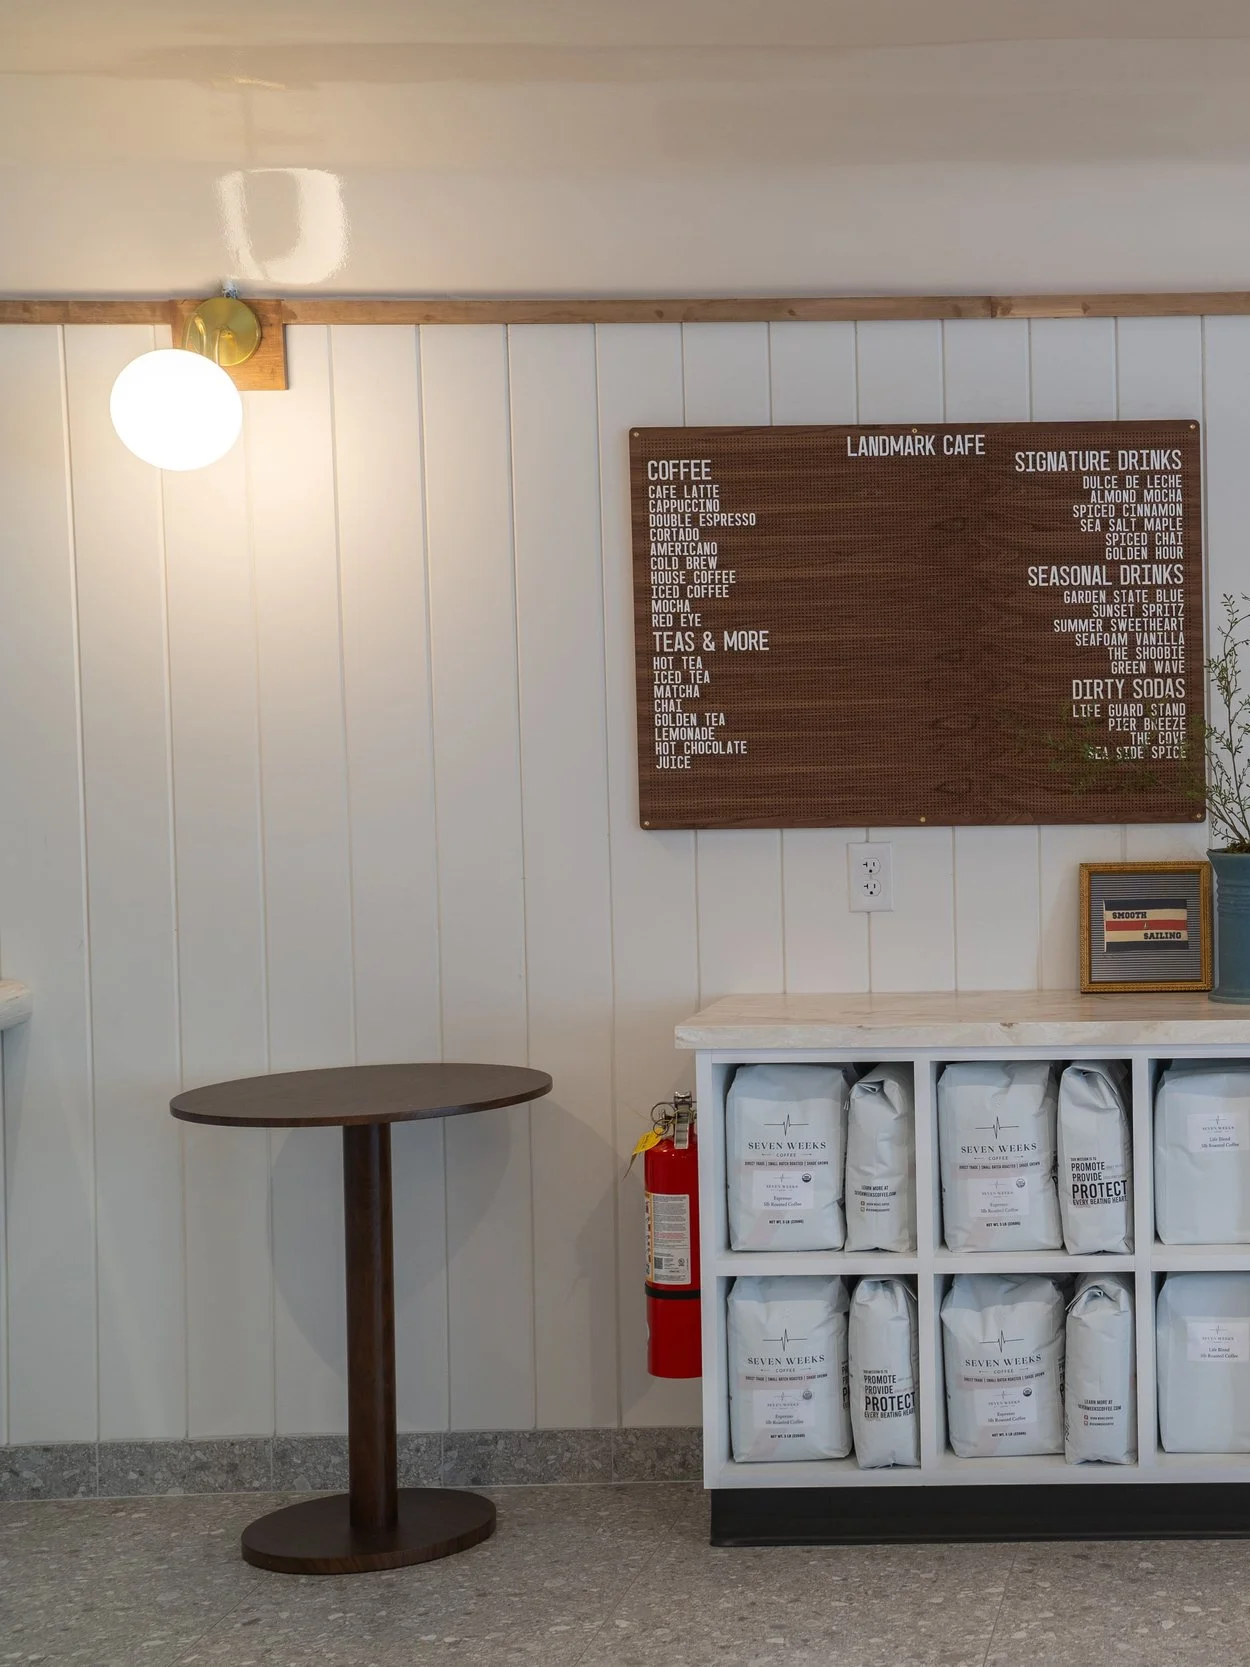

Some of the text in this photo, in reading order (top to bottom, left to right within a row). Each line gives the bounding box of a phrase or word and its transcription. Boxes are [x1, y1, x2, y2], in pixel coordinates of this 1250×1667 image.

[847, 435, 985, 456] LANDMARK CAFE
[1016, 450, 1181, 471] SIGNATURE DRINKS
[648, 460, 711, 480] COFFEE
[1083, 475, 1182, 489] DULCE DE LECHE
[649, 485, 719, 498] CAFE LATTE
[1091, 489, 1182, 503] ALMOND MOCHA
[649, 499, 719, 513] CAPPUCCINO
[1073, 503, 1182, 517] SPICED CINNAMON
[650, 513, 755, 527] DOUBLE ESPRESSO
[1081, 518, 1182, 531] SEA SALT MAPLE
[650, 528, 699, 541] CORTADO
[1106, 532, 1183, 545] SPICED CHAI
[651, 542, 717, 555] AMERICANO
[1106, 546, 1183, 560] GOLDEN HOUR
[651, 556, 717, 570] COLD BREW
[651, 571, 735, 584] HOUSE COFFEE
[1028, 564, 1183, 586] SEASONAL DRINKS
[652, 585, 729, 598] ICED COFFEE
[1064, 589, 1184, 603] GARDEN STATE BLUE
[652, 600, 690, 612] MOCHA
[1093, 603, 1184, 617] SUNSET SPRITZ
[652, 614, 701, 627] RED EYE
[1054, 618, 1184, 632] SUMMER SWEETHEART
[653, 631, 769, 651] TEAS & MORE
[1076, 632, 1184, 646] SEAFOAM VANILLA
[1108, 646, 1184, 660] THE SHOOBIE
[654, 656, 702, 669] HOT TEA
[1112, 661, 1184, 674] GREEN WAVE
[654, 671, 710, 684] ICED TEA
[654, 685, 699, 698] MATCHA
[1073, 679, 1185, 699] DIRTY SODAS
[655, 699, 682, 712] CHAI
[1073, 703, 1185, 717] LIFE GUARD STAND
[655, 713, 725, 726] GOLDEN TEA
[1109, 717, 1185, 731] PIER BREEZE
[655, 727, 714, 740] LEMONADE
[1131, 732, 1186, 745] THE COVE
[656, 741, 747, 755] HOT CHOCOLATE
[1117, 746, 1143, 759] SIDE
[1152, 746, 1186, 758] SPICE
[656, 756, 690, 769] JUICE
[748, 1142, 782, 1150] SEVEN
[961, 1143, 1037, 1154] SEVEN WEEKS
[1071, 1162, 1105, 1171] PROMOTE
[1072, 1172, 1102, 1181] PROVIDE
[1072, 1180, 1127, 1199] PROTECT
[786, 1355, 825, 1365] WEEKS
[1004, 1354, 1041, 1366] WEEKS
[864, 1375, 896, 1384] PROMOTE
[865, 1385, 893, 1394] PROVIDE
[865, 1392, 915, 1411] PROTECT
